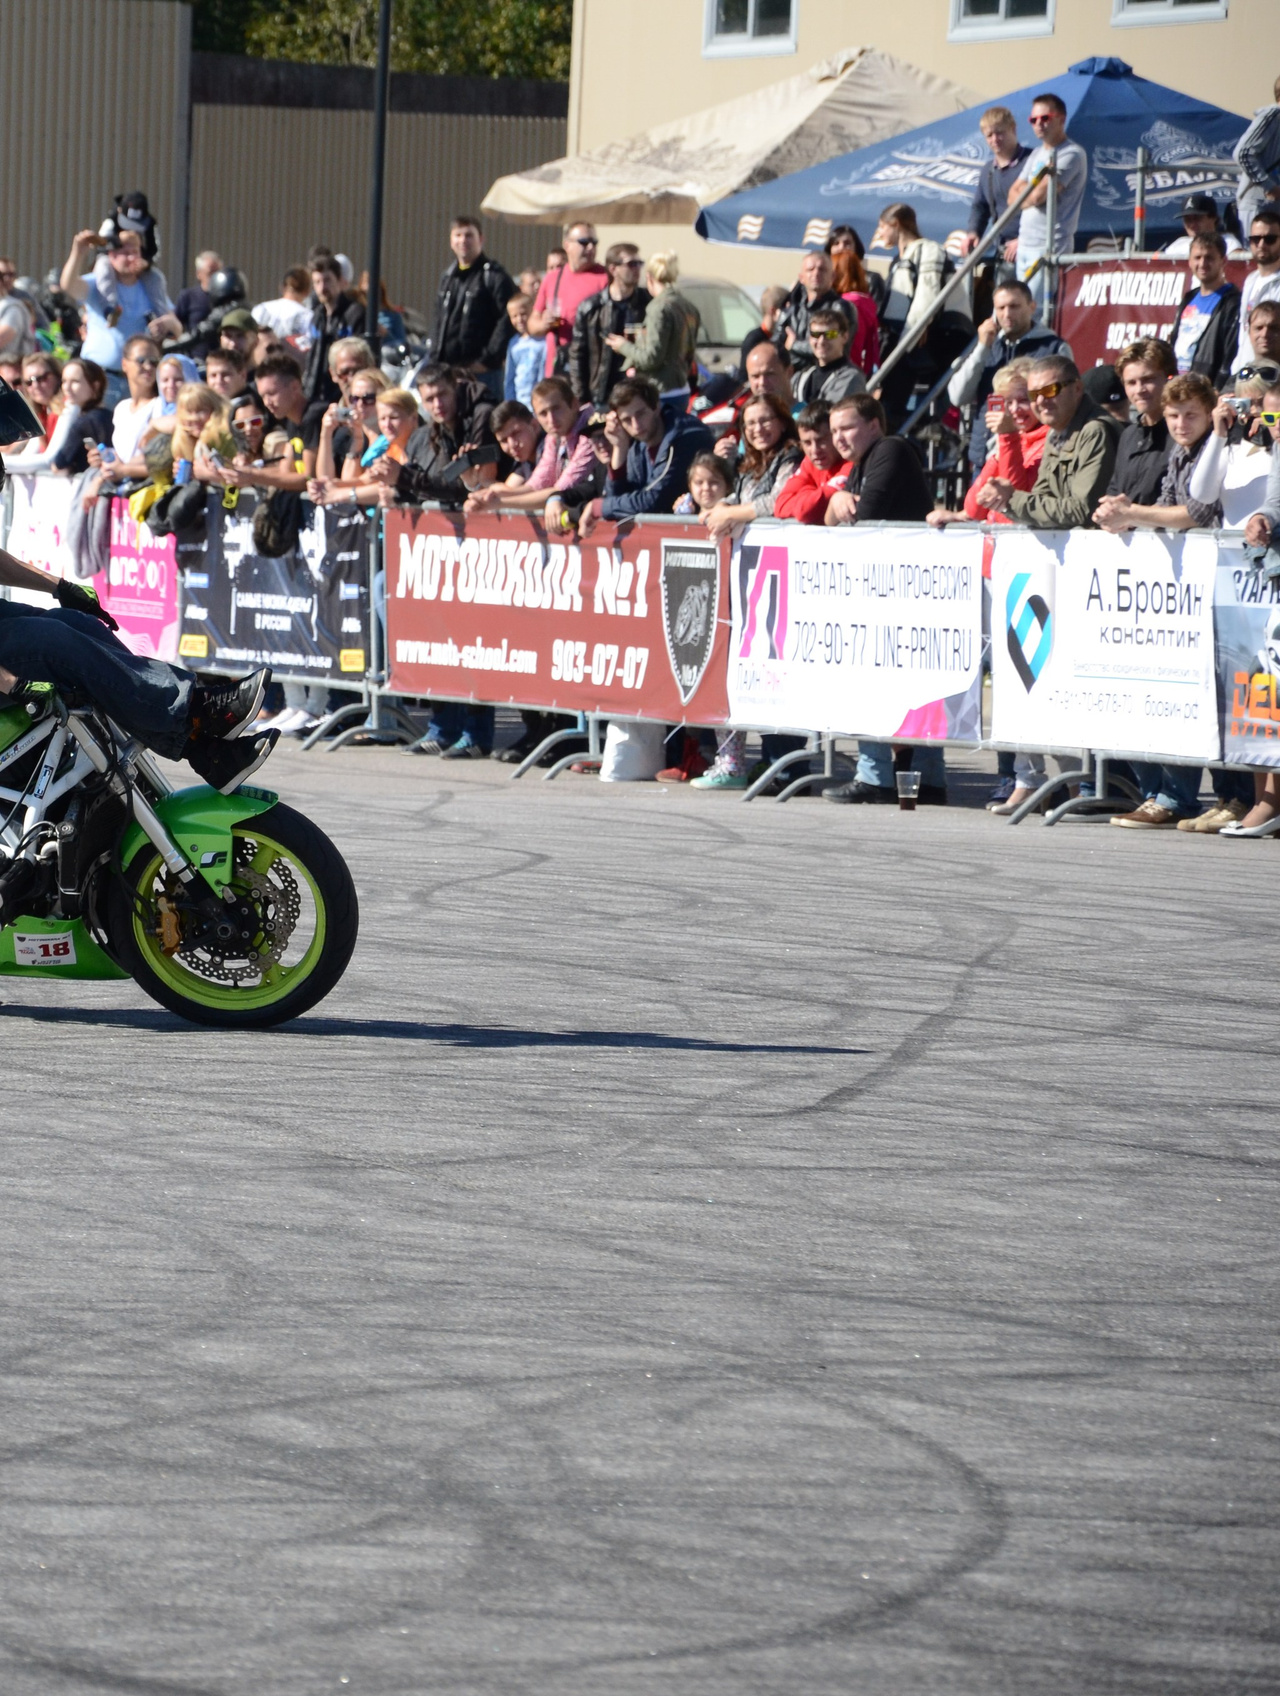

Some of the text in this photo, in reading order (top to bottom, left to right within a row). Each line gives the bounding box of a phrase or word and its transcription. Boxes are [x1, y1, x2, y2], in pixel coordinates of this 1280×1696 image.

[395, 533, 650, 618] МОТОШКОЛА №1
[794, 560, 852, 597] ПЕЧАТАТЬ
[862, 563, 896, 598] НАША
[1086, 568, 1204, 625] А.Бровин
[395, 636, 650, 690] www.moto-school.com 903-07-07
[791, 620, 972, 673] 702-90-77 LINE-PRINT.RU
[37, 940, 70, 958] 18
